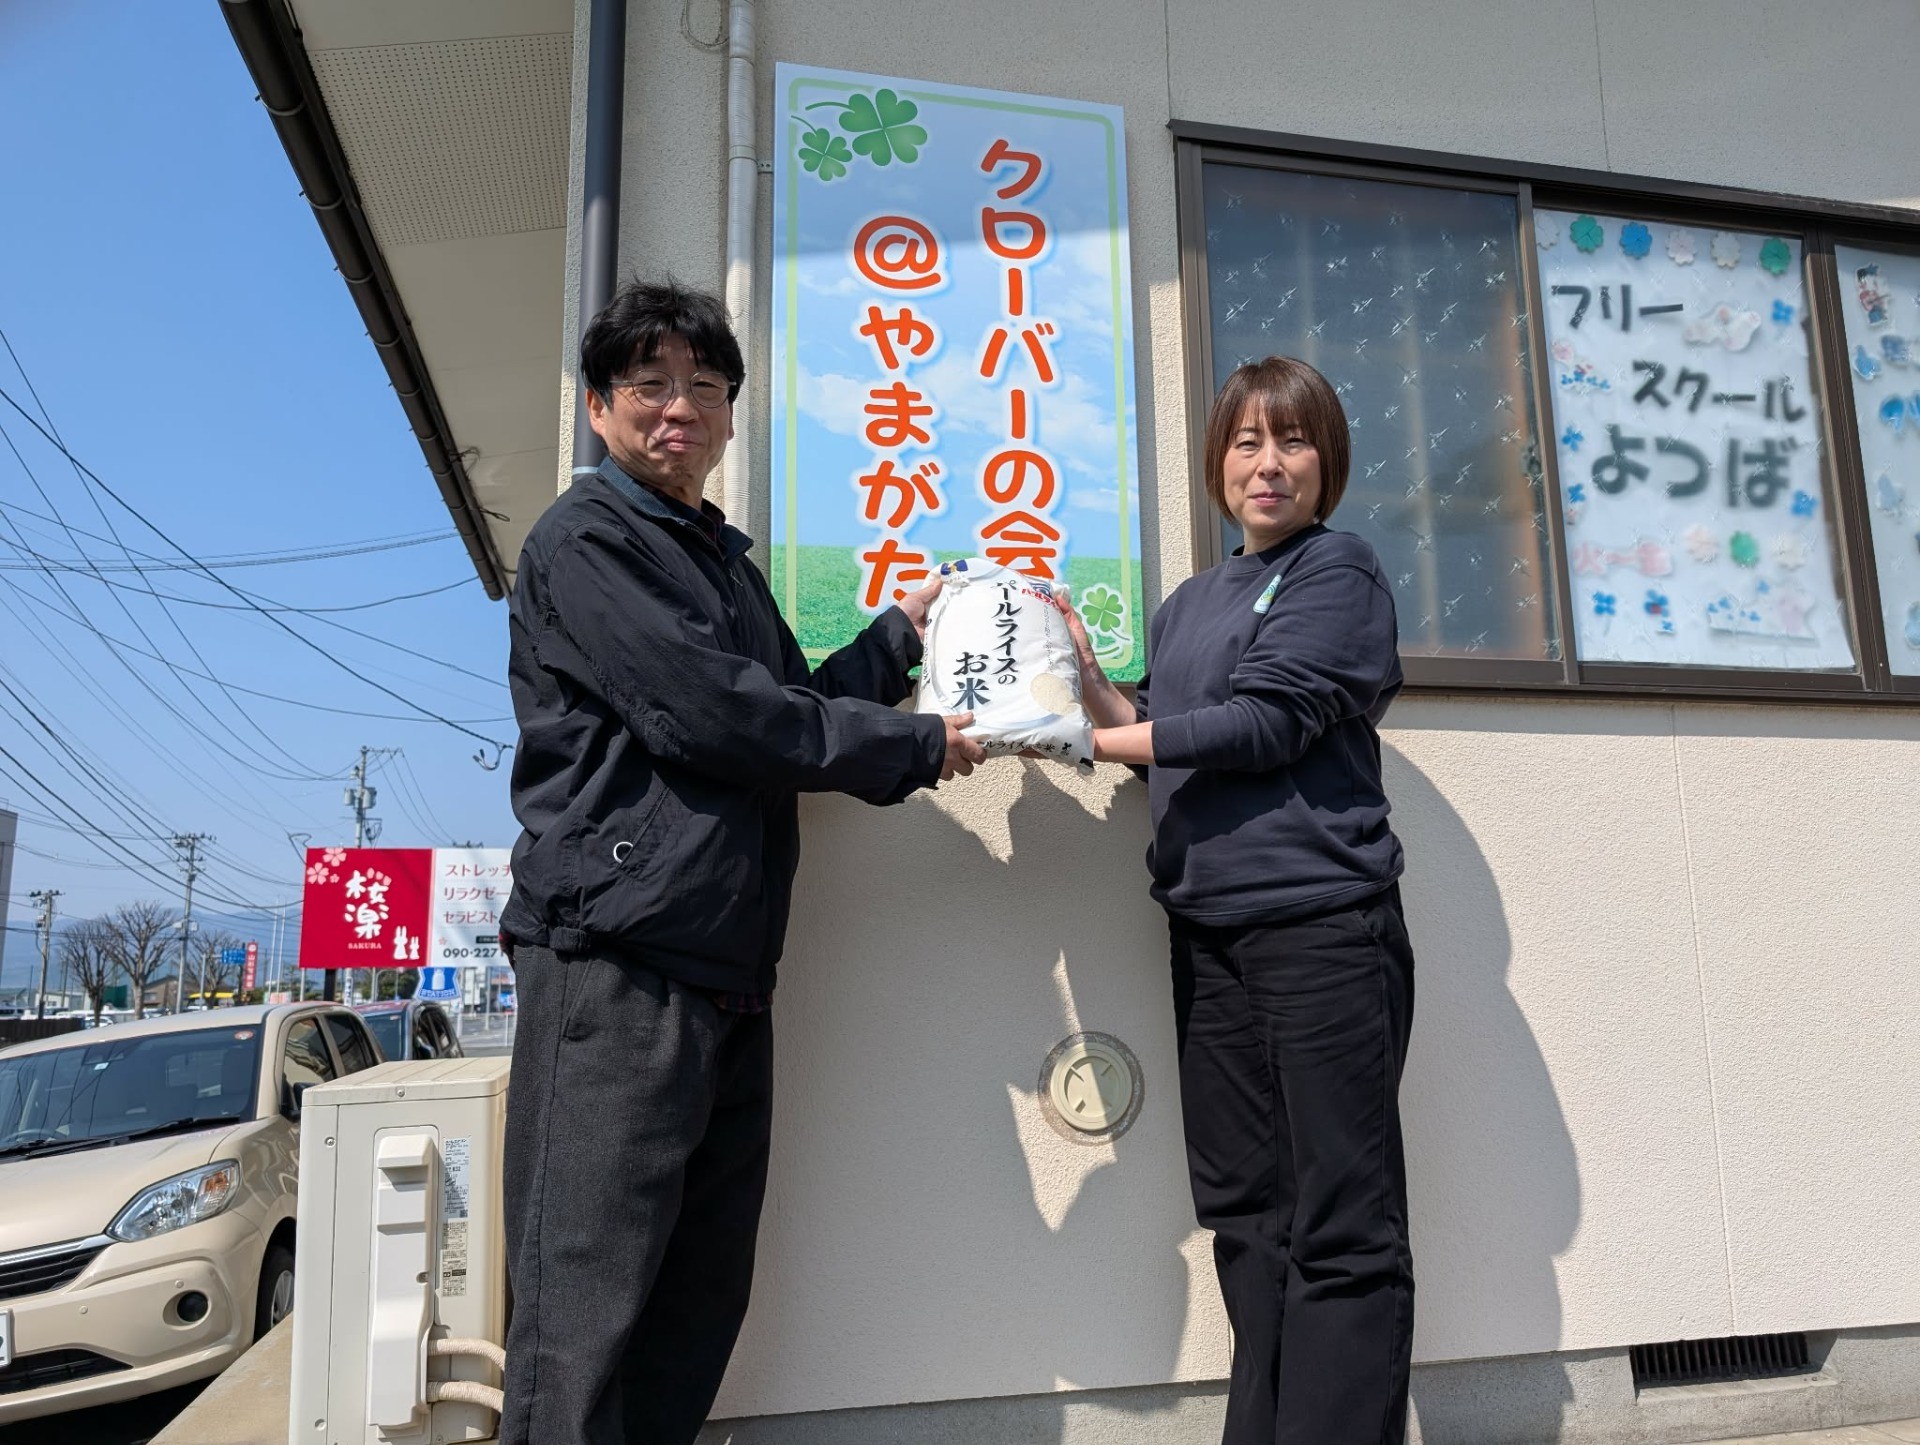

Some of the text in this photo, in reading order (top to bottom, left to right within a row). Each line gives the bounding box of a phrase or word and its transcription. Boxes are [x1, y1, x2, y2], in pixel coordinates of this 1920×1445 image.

[1551, 284, 1685, 332] フリー
[980, 138, 1061, 580] クローバーの会
[853, 215, 941, 608] @やまがた
[1632, 359, 1806, 423] スクール
[1591, 424, 1800, 509] よつば
[952, 652, 990, 710] お米
[347, 942, 382, 950] SAKURA
[420, 988, 456, 998] STATION
